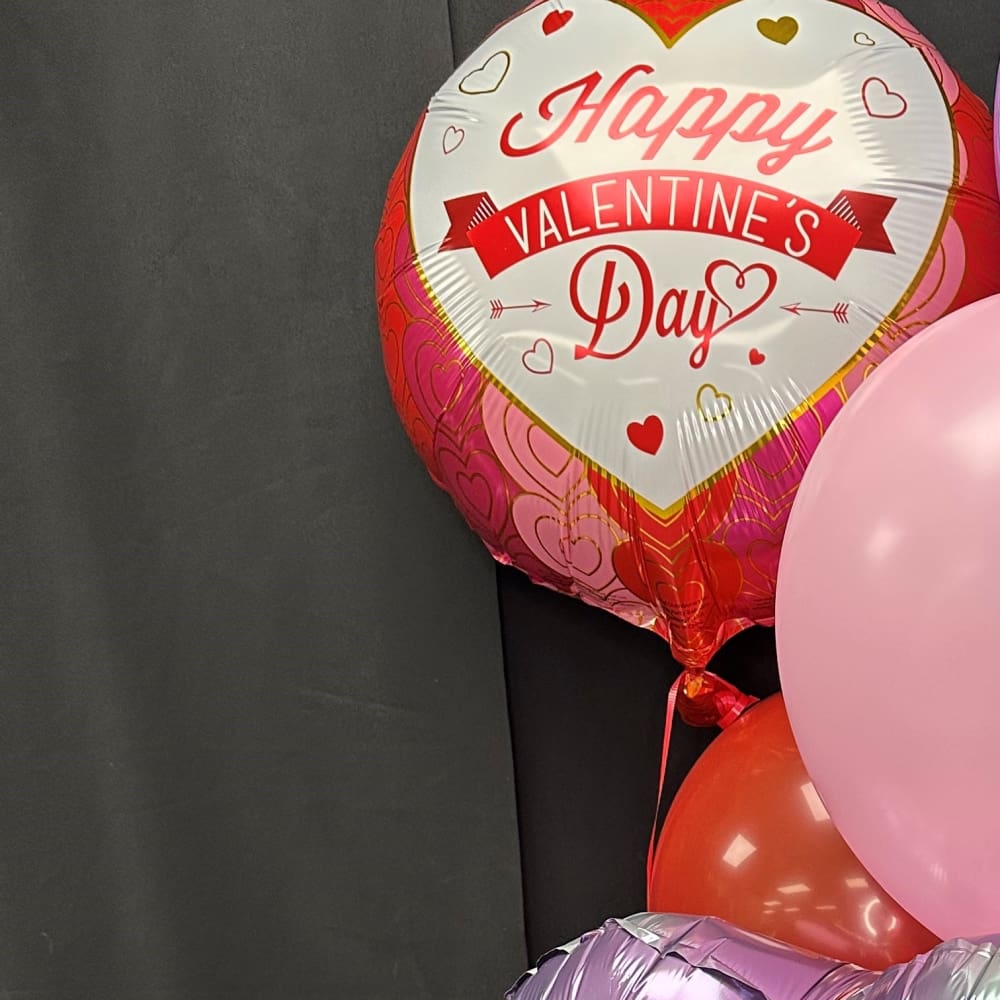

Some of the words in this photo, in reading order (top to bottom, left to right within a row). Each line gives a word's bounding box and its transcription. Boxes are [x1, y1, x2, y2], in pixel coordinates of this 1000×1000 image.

[499, 63, 838, 176] Happy
[503, 174, 821, 259] VALENTINE'S
[569, 243, 778, 370] Day
